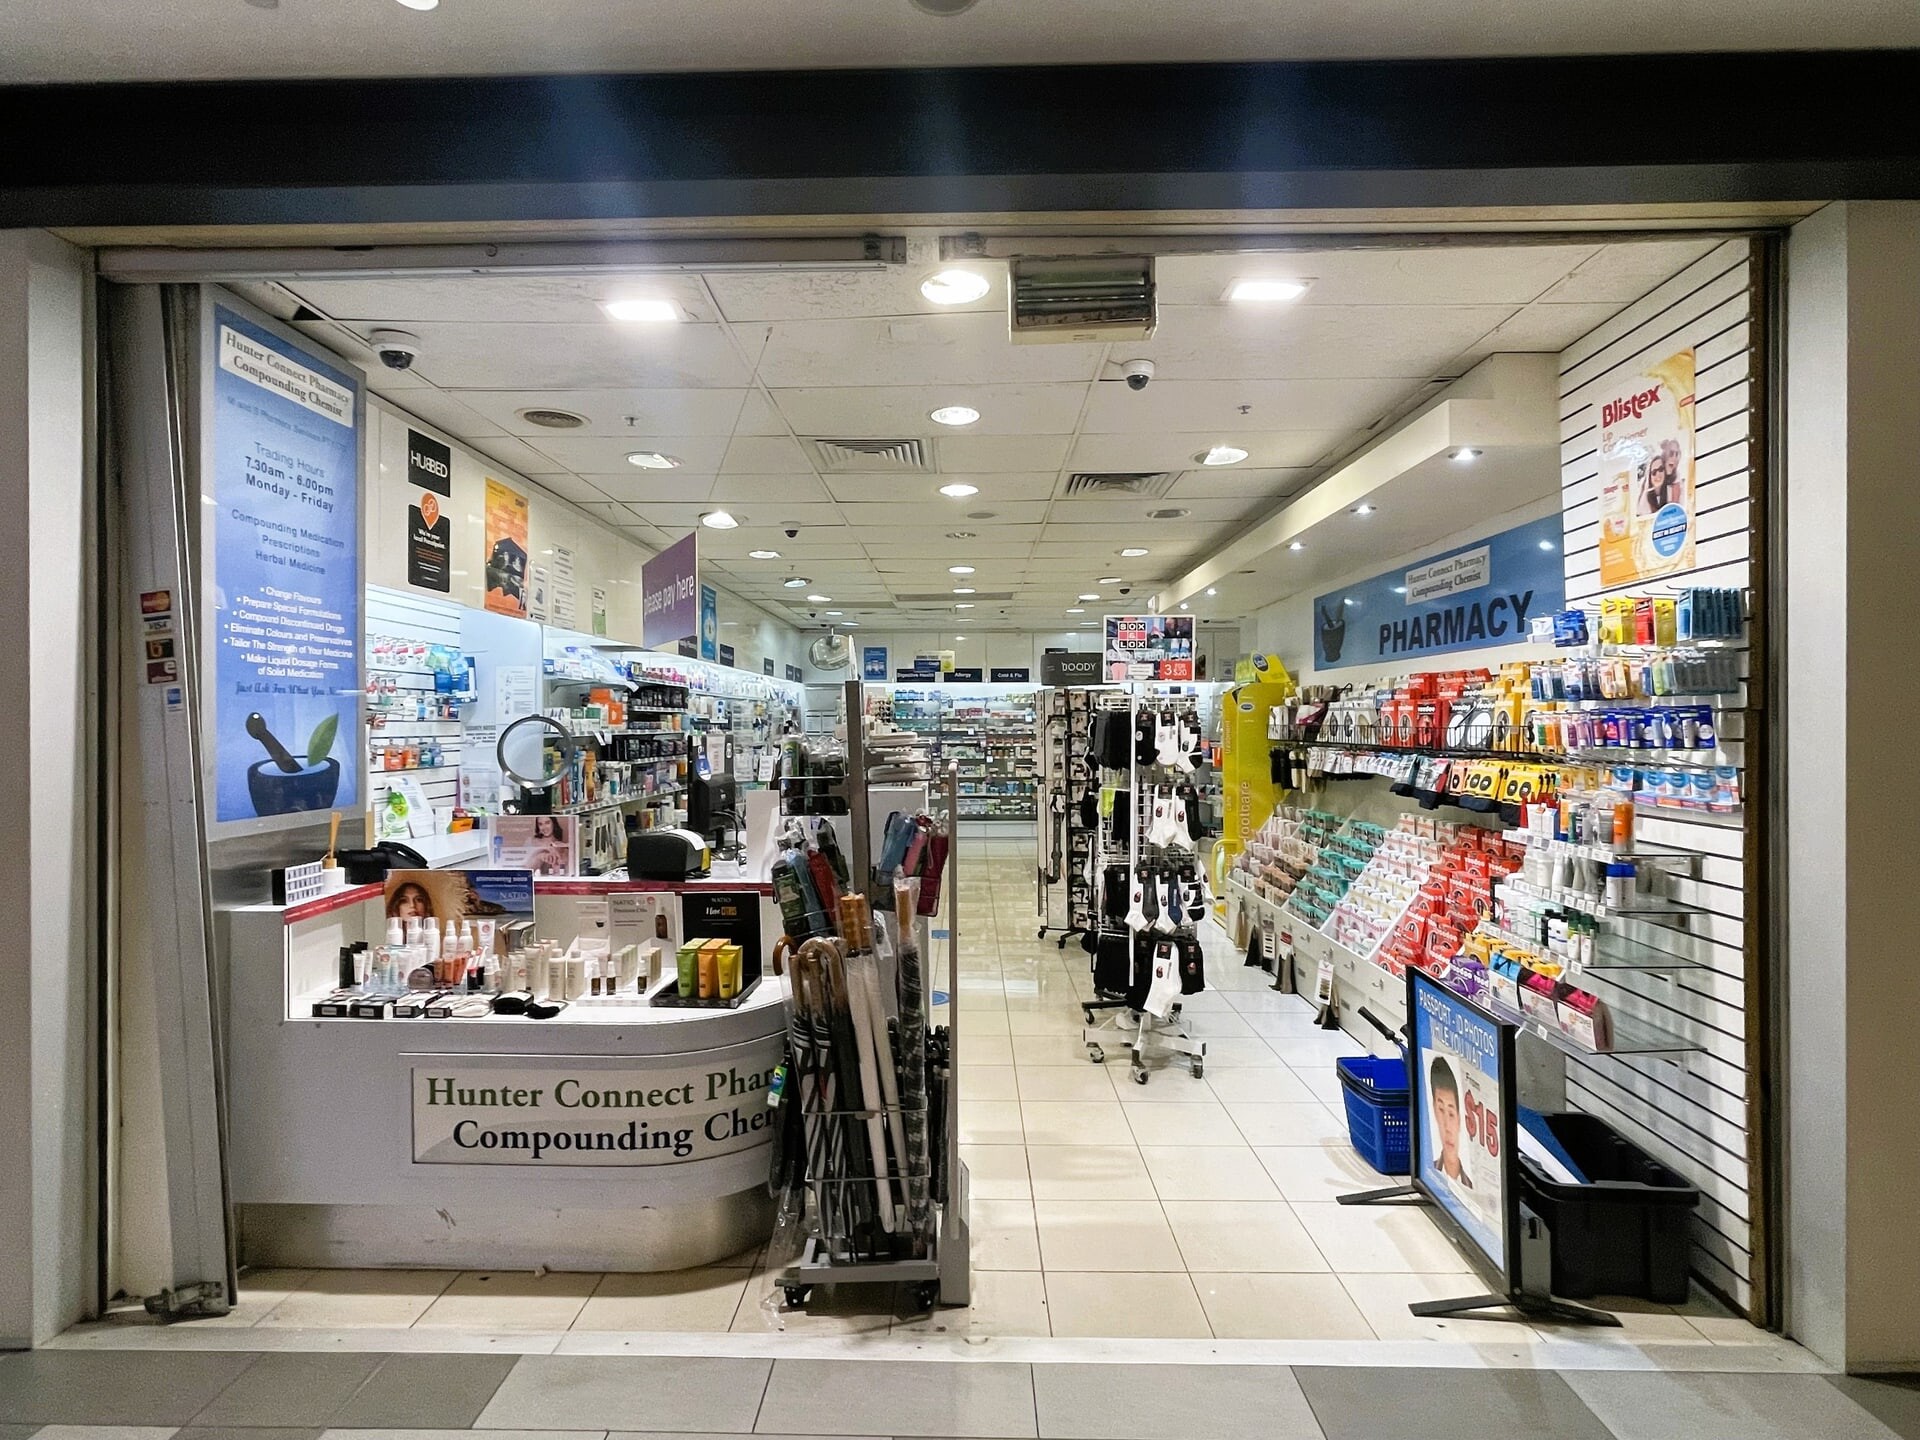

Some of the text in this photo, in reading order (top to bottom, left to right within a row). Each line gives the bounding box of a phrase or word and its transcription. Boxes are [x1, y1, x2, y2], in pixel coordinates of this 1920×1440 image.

[226, 332, 349, 405] Hunter Connect Pharmacy
[234, 355, 342, 417] Compounding Chemist
[1602, 385, 1660, 428] Blistex
[254, 442, 325, 478] Trading Hours
[410, 450, 447, 478] HUBBED
[245, 456, 285, 480] 7.30am
[297, 475, 334, 497] 6.00pm
[246, 473, 290, 500] Monday
[301, 493, 334, 514] Friday
[232, 509, 345, 549] Compounding Medication
[262, 534, 320, 558] Prescriptions
[255, 550, 326, 575] Herbal Medicine
[1408, 554, 1488, 584] Hunter Connect Pharmacy
[663, 584, 675, 614] pay
[676, 574, 694, 600] here
[1412, 569, 1481, 597] Compounding Chemist
[243, 596, 272, 610] Prepare
[273, 602, 297, 615] Special
[231, 623, 264, 636] Eliminate
[266, 628, 293, 640] Colours
[294, 632, 308, 642] and
[239, 610, 345, 634] Compound Discontinued Drugs
[1119, 622, 1146, 631] SOX
[1379, 590, 1534, 655] PHARMACY
[230, 637, 251, 648] Tailor
[252, 640, 266, 650] The
[267, 642, 297, 654] Strength
[299, 645, 306, 653] of
[307, 646, 323, 655] Your
[1119, 640, 1146, 648] LOX
[246, 653, 266, 664] Make
[267, 656, 290, 667] Liquid
[292, 658, 318, 668] Dosage
[258, 666, 266, 675] of
[267, 667, 286, 676] Solid
[1164, 663, 1172, 675] 3
[500, 892, 528, 900] NATIO
[1419, 988, 1451, 1025] PASSPORT
[1464, 1018, 1495, 1057] PHOTOS
[426, 1077, 543, 1107] Hunter
[554, 1079, 694, 1109] Connect
[1464, 1089, 1499, 1157] $15
[453, 1120, 694, 1158] Compounding
